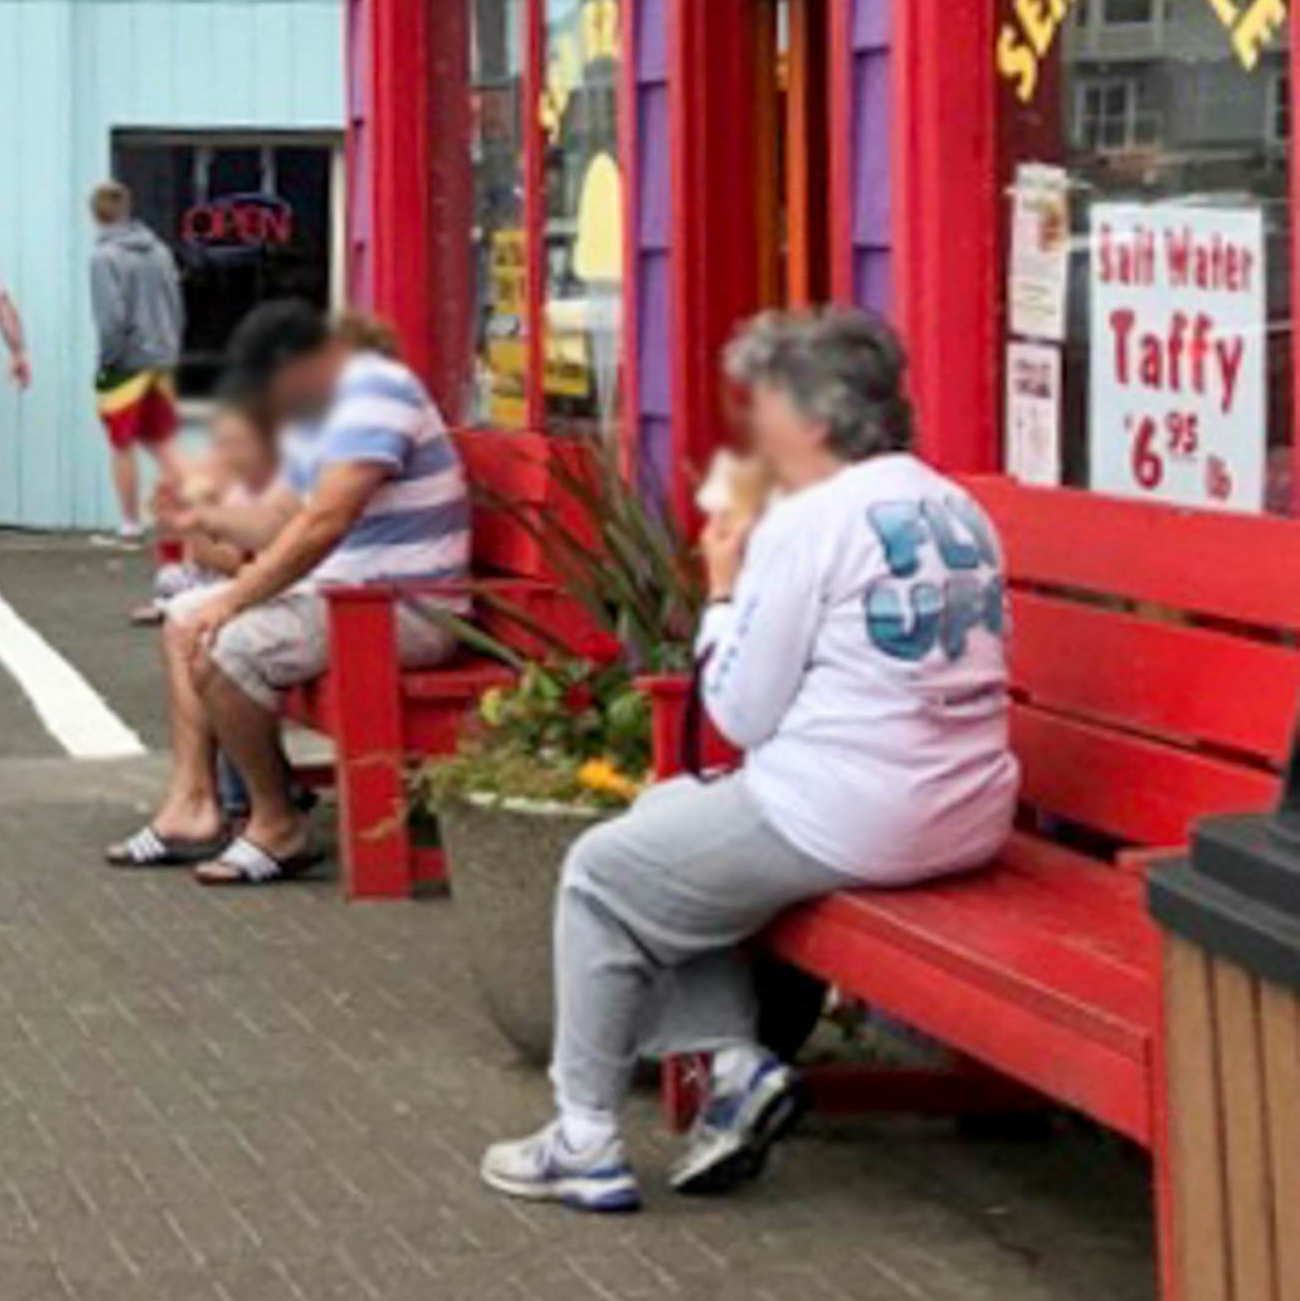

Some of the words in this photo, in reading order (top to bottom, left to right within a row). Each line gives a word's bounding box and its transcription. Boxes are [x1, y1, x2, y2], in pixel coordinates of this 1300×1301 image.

[182, 203, 290, 245] OPEN
[1099, 222, 1155, 287] Salt
[1164, 221, 1253, 292] Water
[1109, 308, 1244, 413] Taffy
